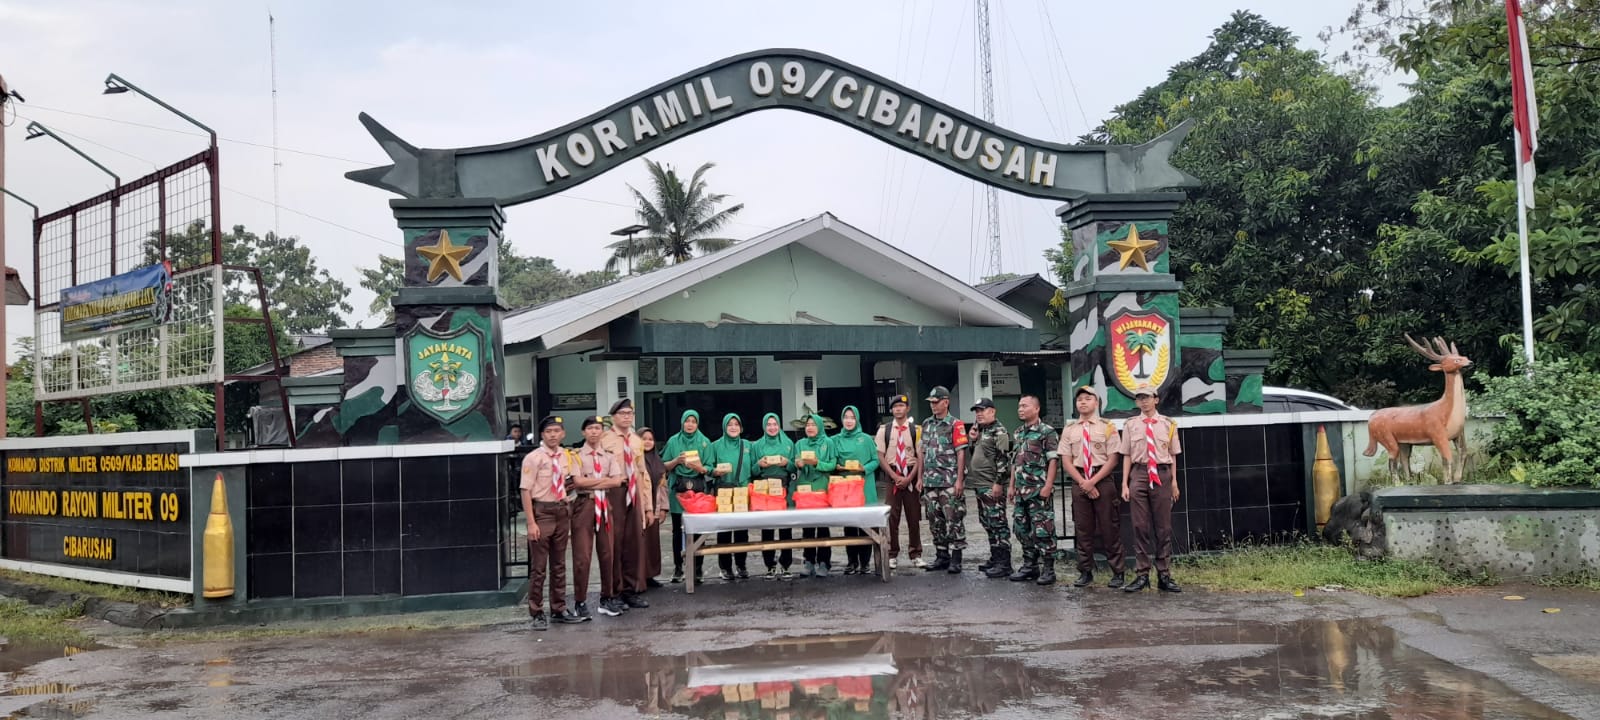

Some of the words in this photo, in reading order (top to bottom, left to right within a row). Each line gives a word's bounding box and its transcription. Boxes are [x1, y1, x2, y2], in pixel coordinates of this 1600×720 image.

[535, 76, 733, 184] KORAMIL
[749, 61, 1058, 188] 09/CIBARUSAH
[417, 342, 473, 360] JAYAKARTA
[8, 457, 36, 472] KOMANDO
[40, 457, 66, 472] DISTRIK
[69, 456, 98, 472] MILITER
[10, 490, 57, 516] KOMANDO
[62, 491, 97, 517] RAYON
[102, 491, 153, 520] MILITER
[159, 493, 179, 522] 09
[63, 536, 112, 561] CIBARUSAH
